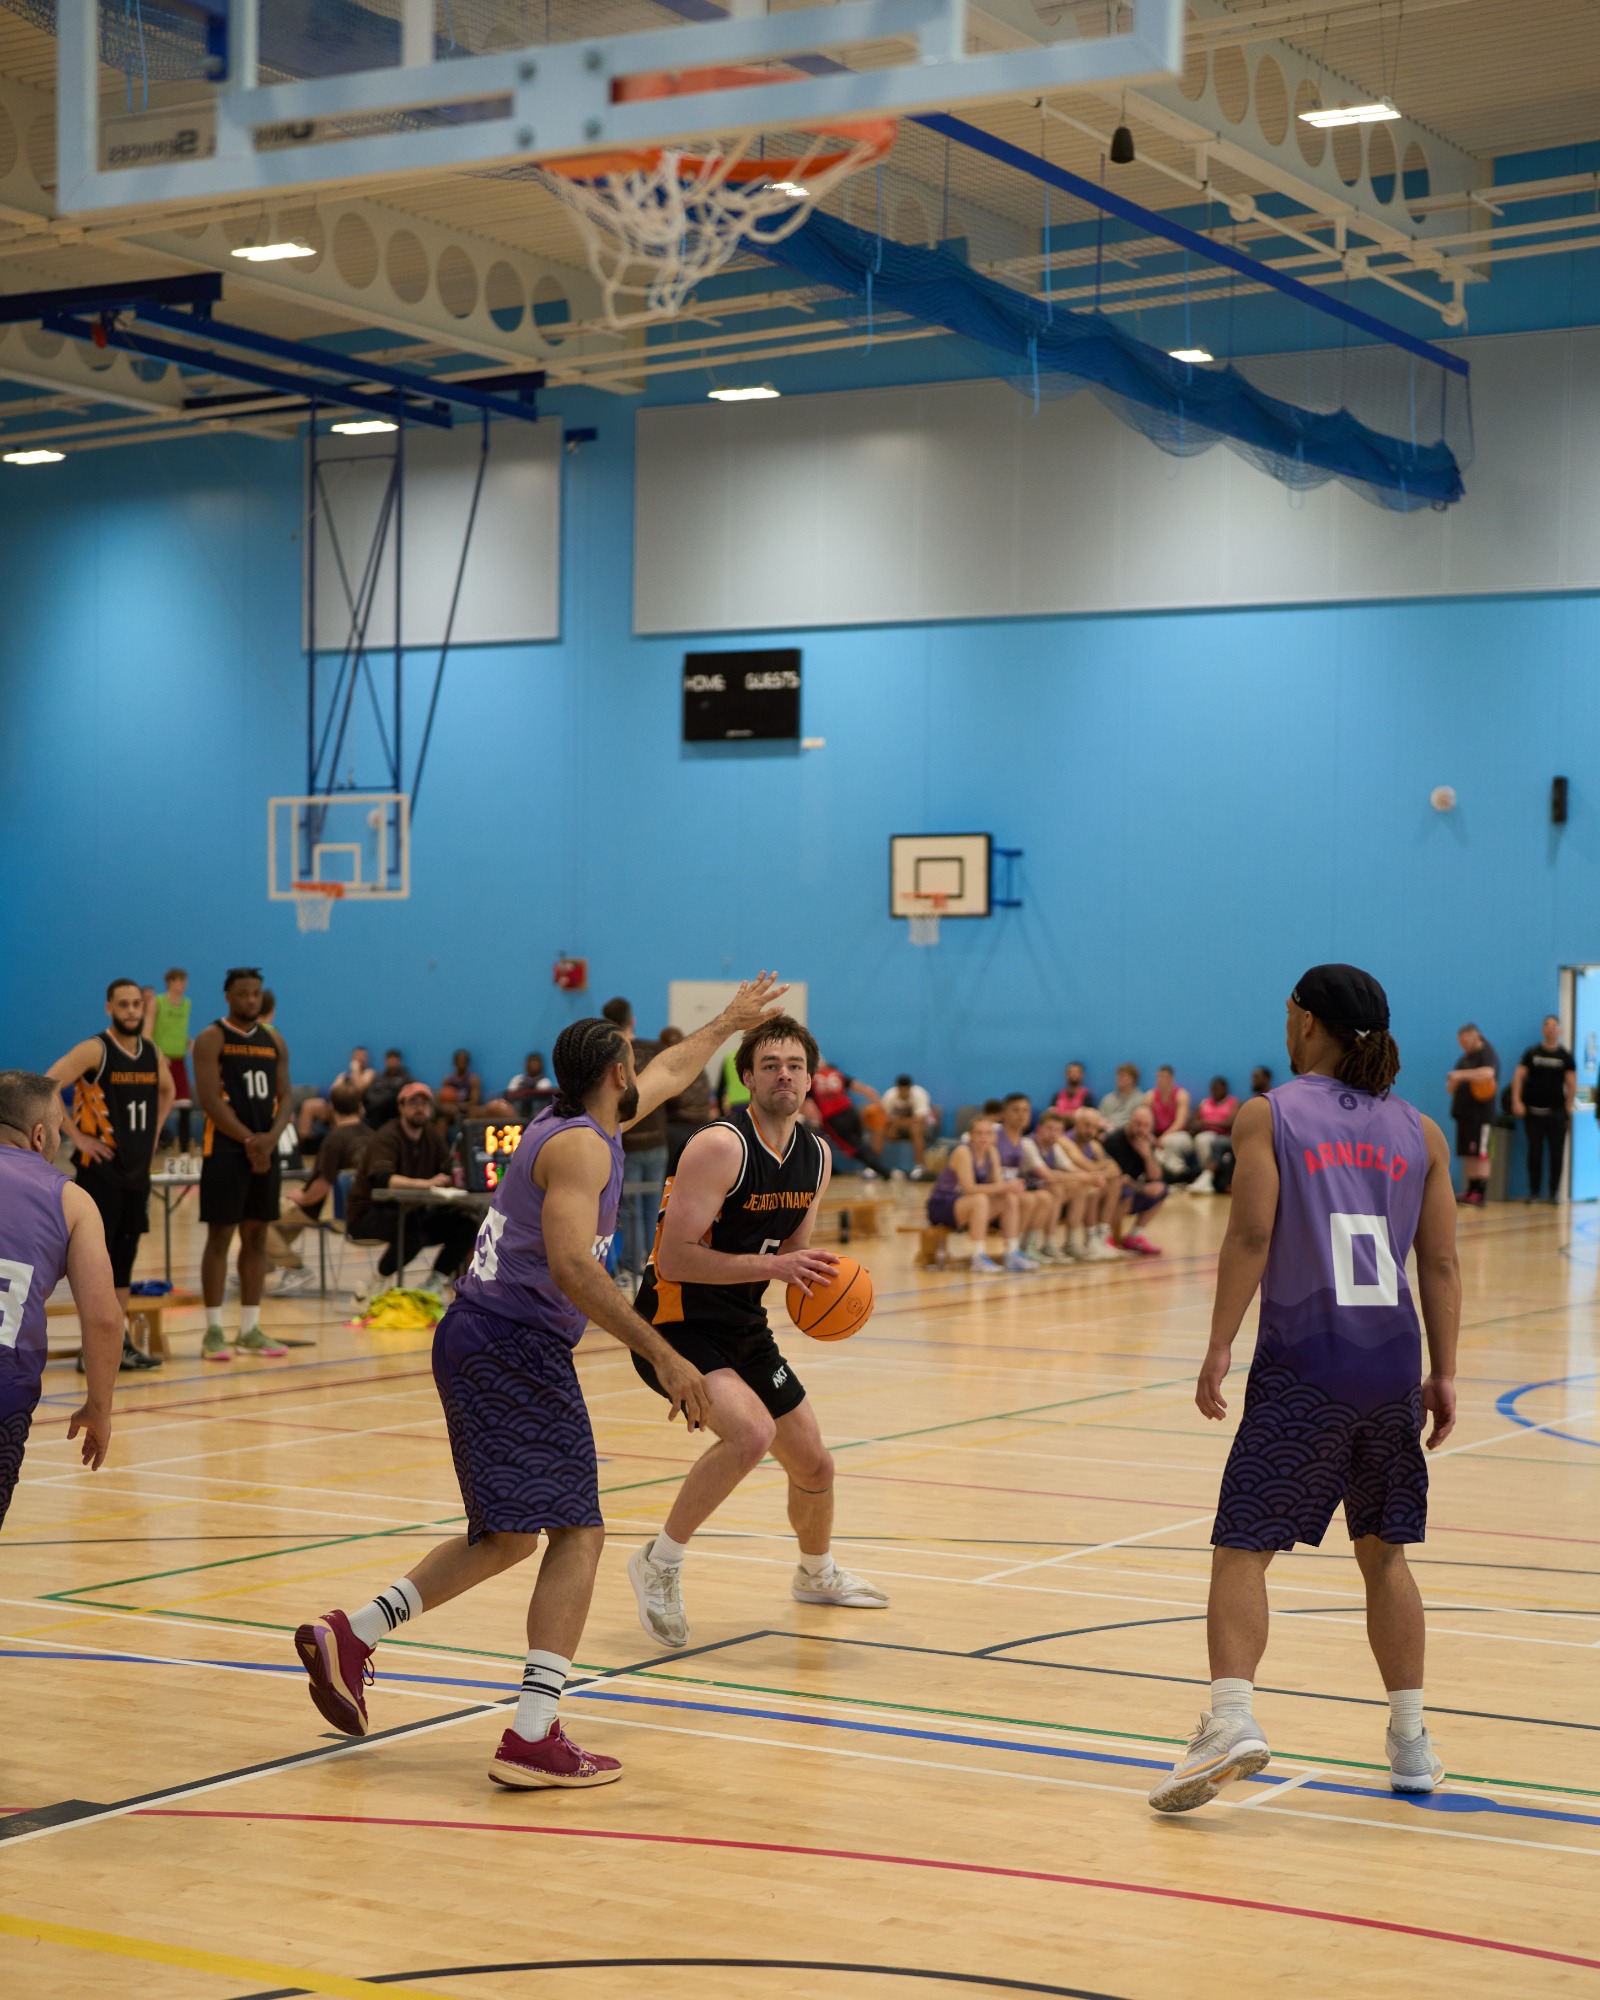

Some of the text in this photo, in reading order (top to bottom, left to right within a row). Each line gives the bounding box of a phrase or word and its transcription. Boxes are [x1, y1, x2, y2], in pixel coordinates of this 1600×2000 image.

[744, 670, 800, 691] GUESTS
[242, 1069, 269, 1099] 10
[126, 1100, 147, 1131] 11
[1330, 1213, 1399, 1306] 0
